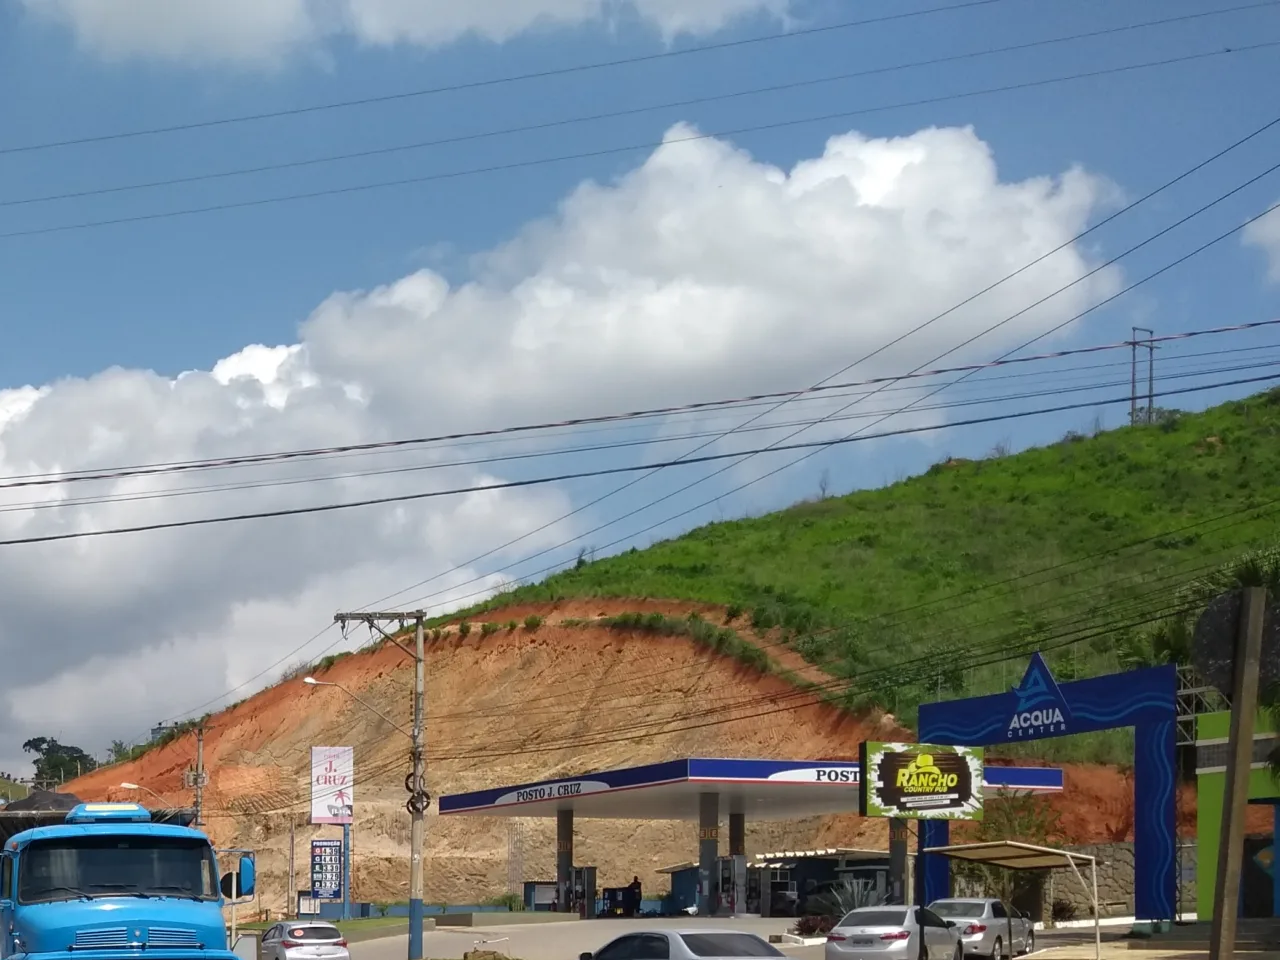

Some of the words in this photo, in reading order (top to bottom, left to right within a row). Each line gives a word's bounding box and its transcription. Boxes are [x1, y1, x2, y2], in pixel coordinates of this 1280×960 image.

[1009, 708, 1064, 729] ACQUA
[1008, 723, 1066, 737] CENTER
[325, 760, 337, 773] J.
[316, 775, 348, 785] CRUZ
[896, 768, 958, 787] RANCHO
[517, 788, 545, 801] POSTO
[547, 786, 555, 798] J.
[558, 783, 581, 796] CRUZ
